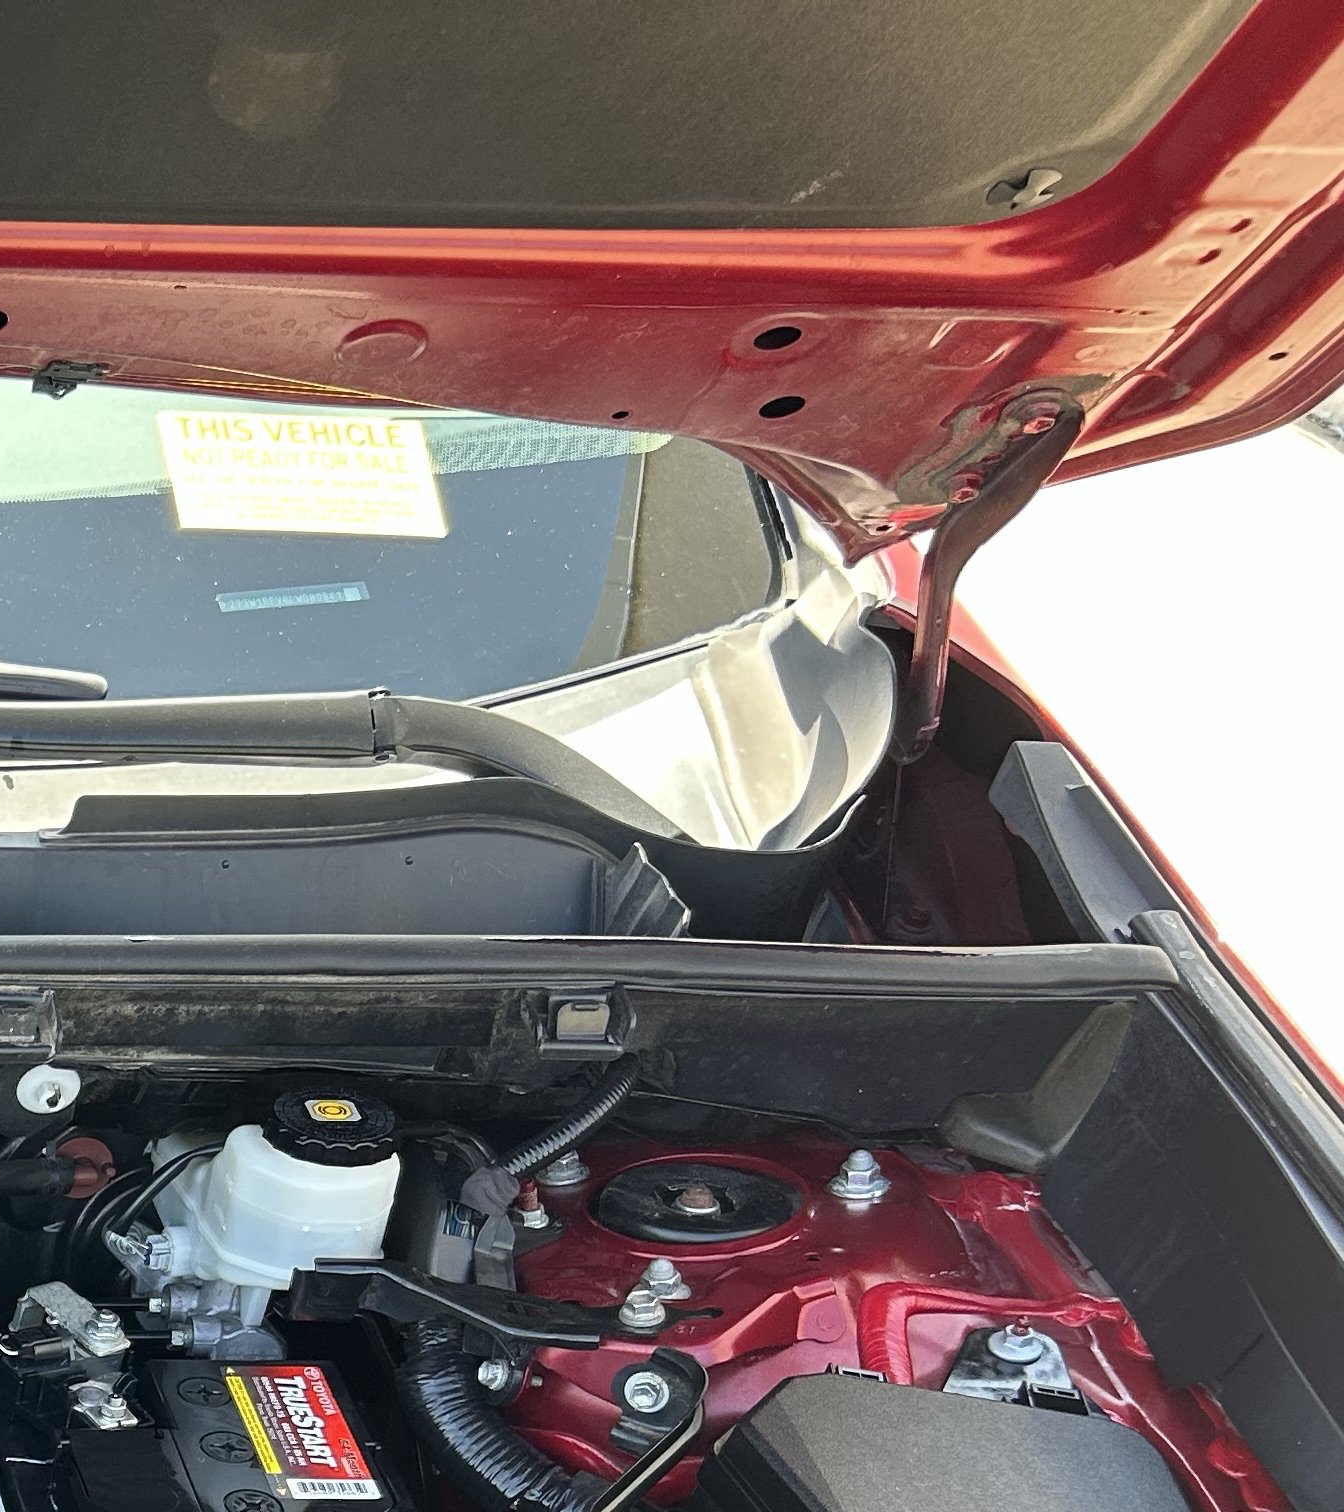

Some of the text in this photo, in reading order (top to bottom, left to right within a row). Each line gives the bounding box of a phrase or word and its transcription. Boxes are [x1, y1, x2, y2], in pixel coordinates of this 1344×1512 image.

[175, 416, 407, 448] THIS VEHICLE
[182, 447, 410, 474] NOT READY FOR SALE
[310, 1380, 337, 1416] TOYOTA
